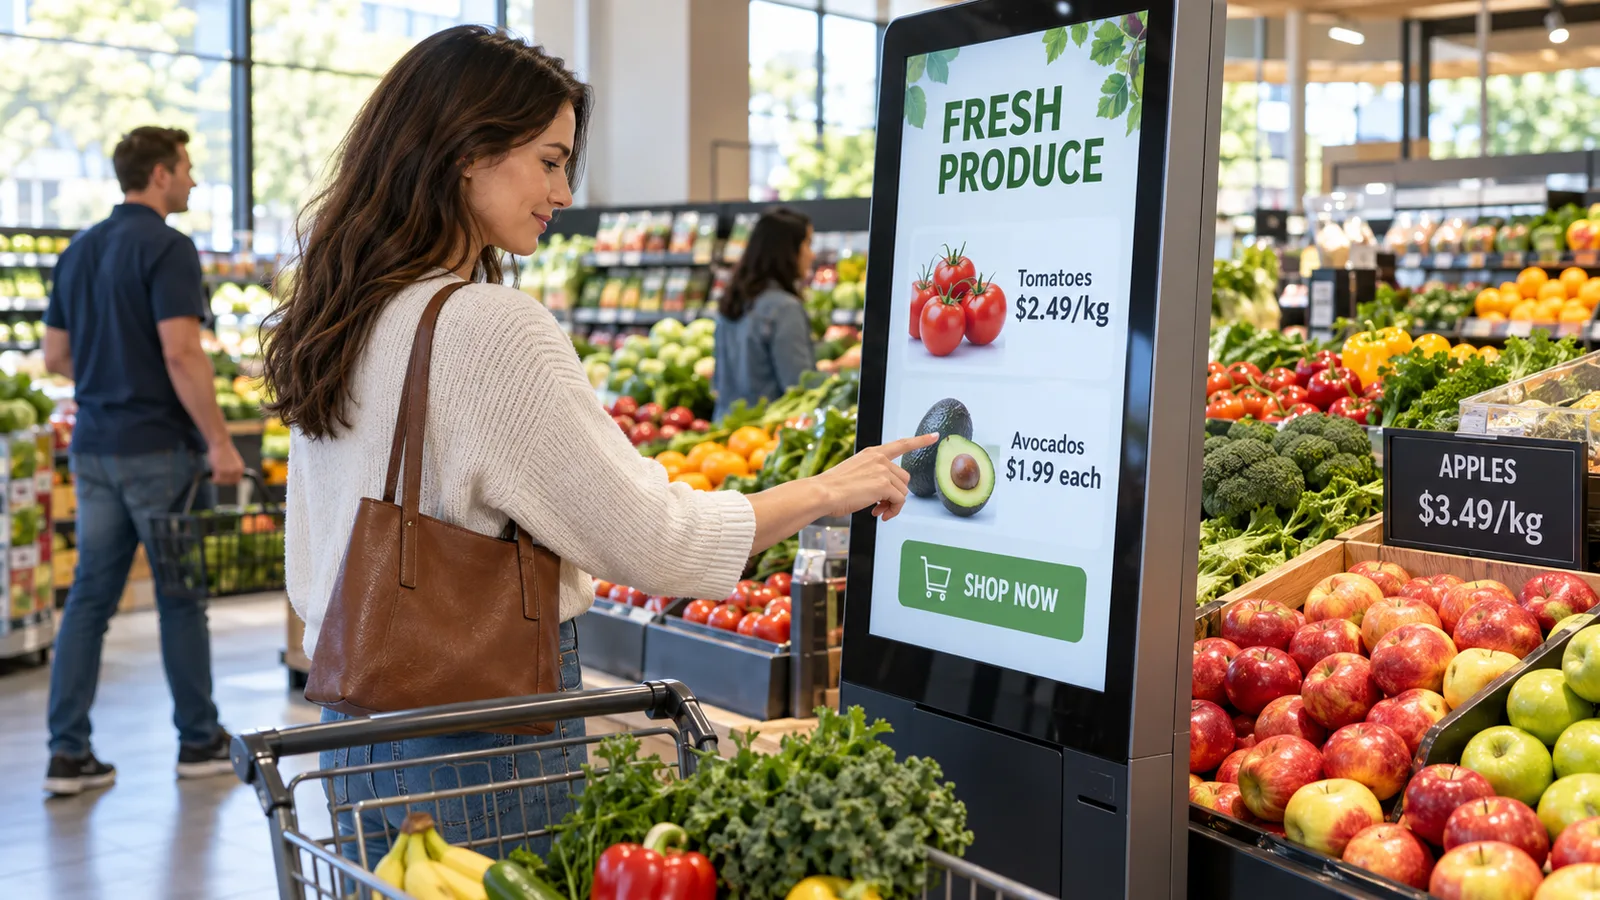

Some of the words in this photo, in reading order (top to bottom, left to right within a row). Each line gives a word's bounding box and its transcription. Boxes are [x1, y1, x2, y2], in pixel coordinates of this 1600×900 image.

[942, 85, 1063, 144] FRESH
[938, 137, 1104, 194] PRODUCE
[1017, 269, 1092, 288] Tomatoes
[1015, 294, 1109, 327] $2.49/kg
[1011, 431, 1085, 456] Avocados
[1005, 456, 1054, 484] $1.99
[1059, 466, 1101, 489] each
[1438, 453, 1517, 484] APPLES
[1418, 489, 1543, 546] $3.49/kg
[963, 572, 1009, 603] SHOP
[1013, 582, 1059, 613] NOW
